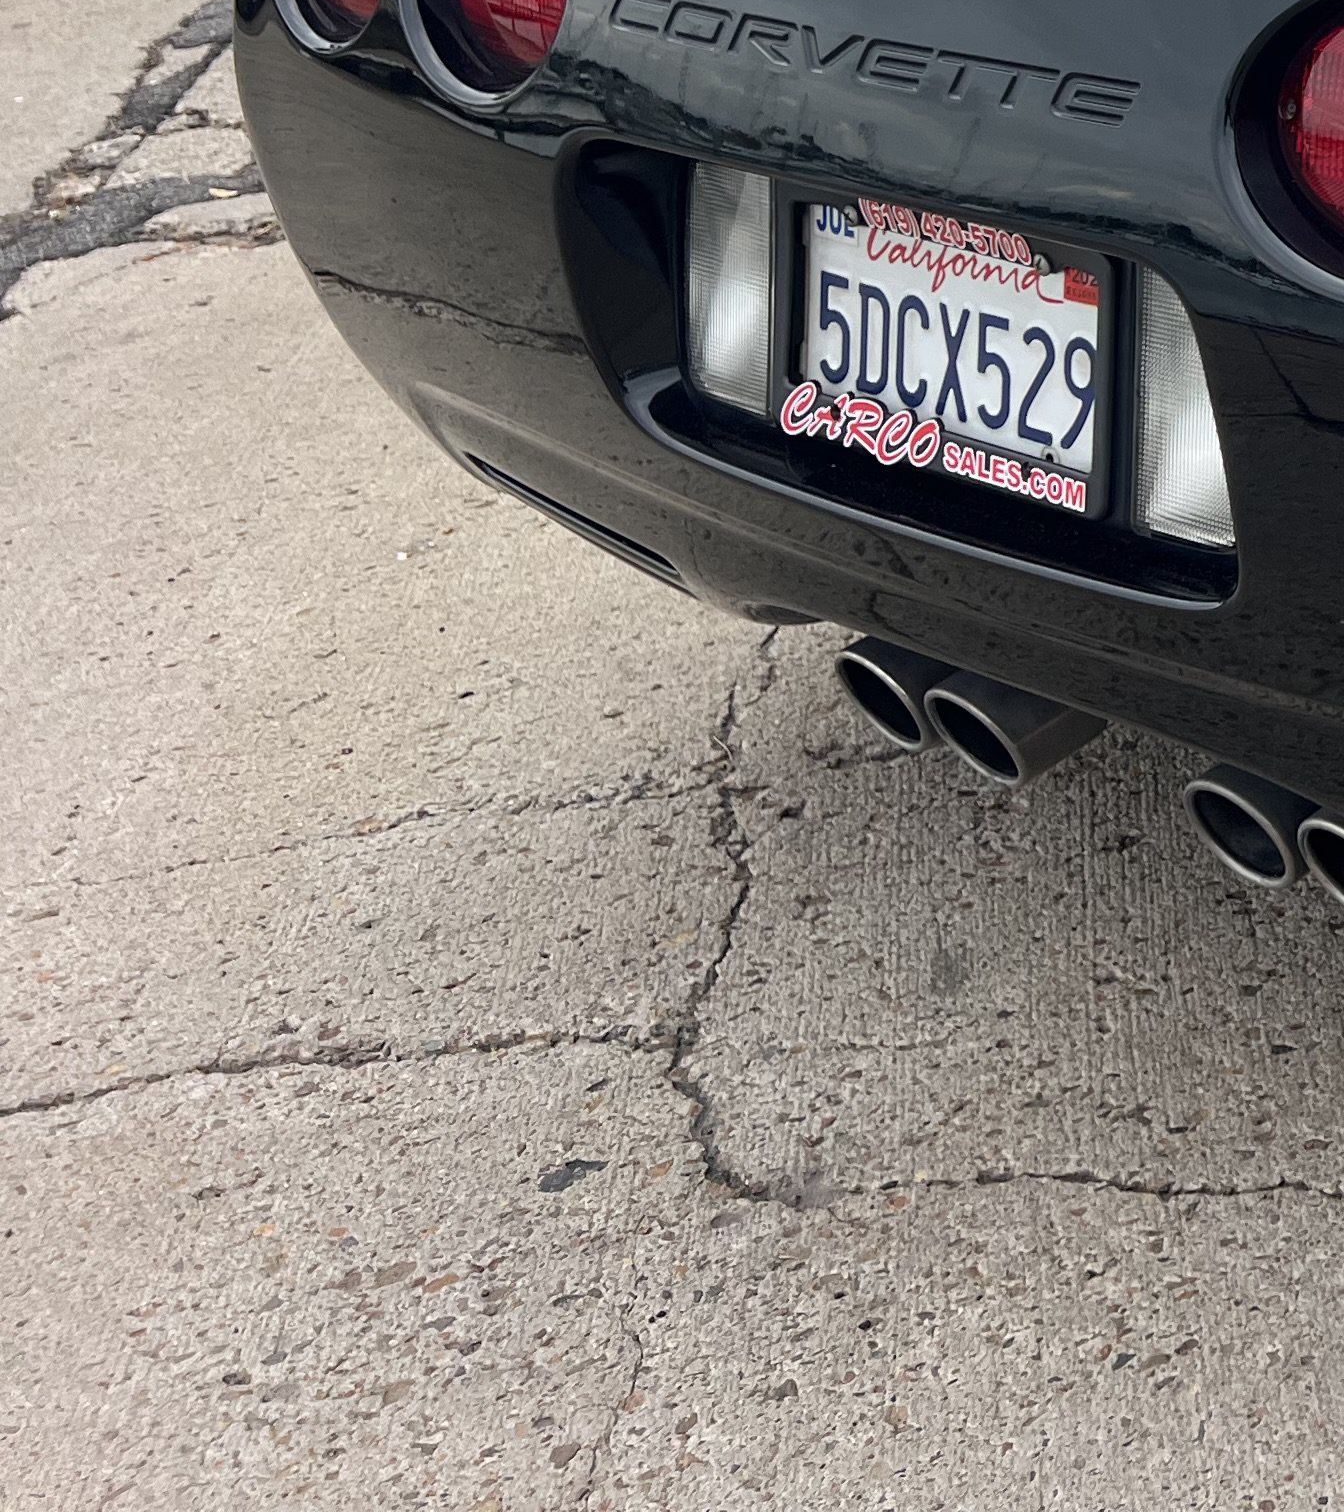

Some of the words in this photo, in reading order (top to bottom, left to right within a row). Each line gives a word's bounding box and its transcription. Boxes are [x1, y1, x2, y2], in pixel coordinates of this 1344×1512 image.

[858, 198, 921, 239] (619)
[921, 211, 1032, 266] 420-5700
[867, 228, 1063, 304] California
[820, 270, 1096, 450] 5DCX529
[780, 381, 940, 466] CARCO
[943, 442, 1087, 513] SALES.COM
